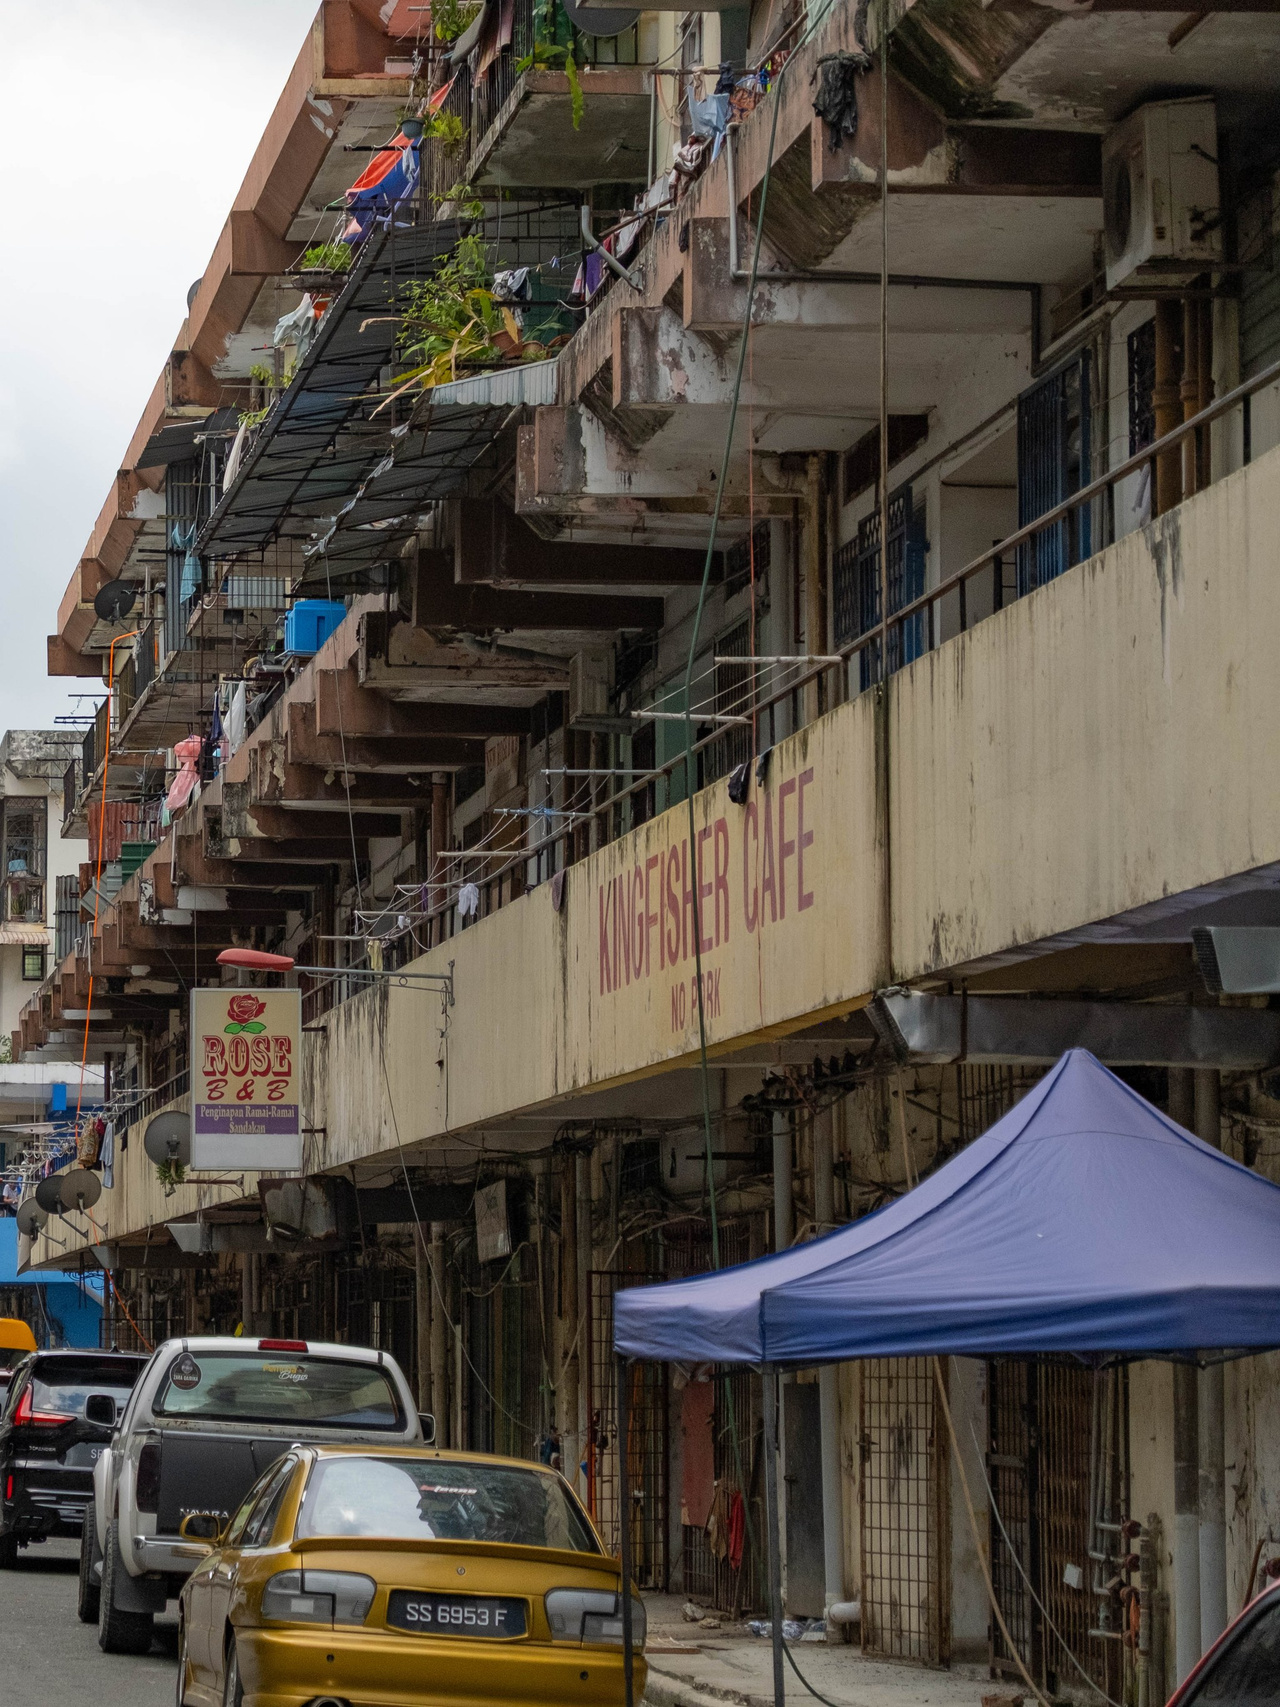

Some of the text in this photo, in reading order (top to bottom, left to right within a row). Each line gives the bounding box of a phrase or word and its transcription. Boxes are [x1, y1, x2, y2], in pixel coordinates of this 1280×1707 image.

[599, 766, 814, 996] KINGFISHER CAFE
[671, 981, 686, 1033] NO
[202, 1035, 292, 1077] ROSE
[206, 1079, 289, 1101] B & B
[200, 1105, 295, 1122] Penginapan Ramai-Ramai
[229, 1121, 266, 1134] Sandakan
[406, 1603, 508, 1627] SS 6953 F
